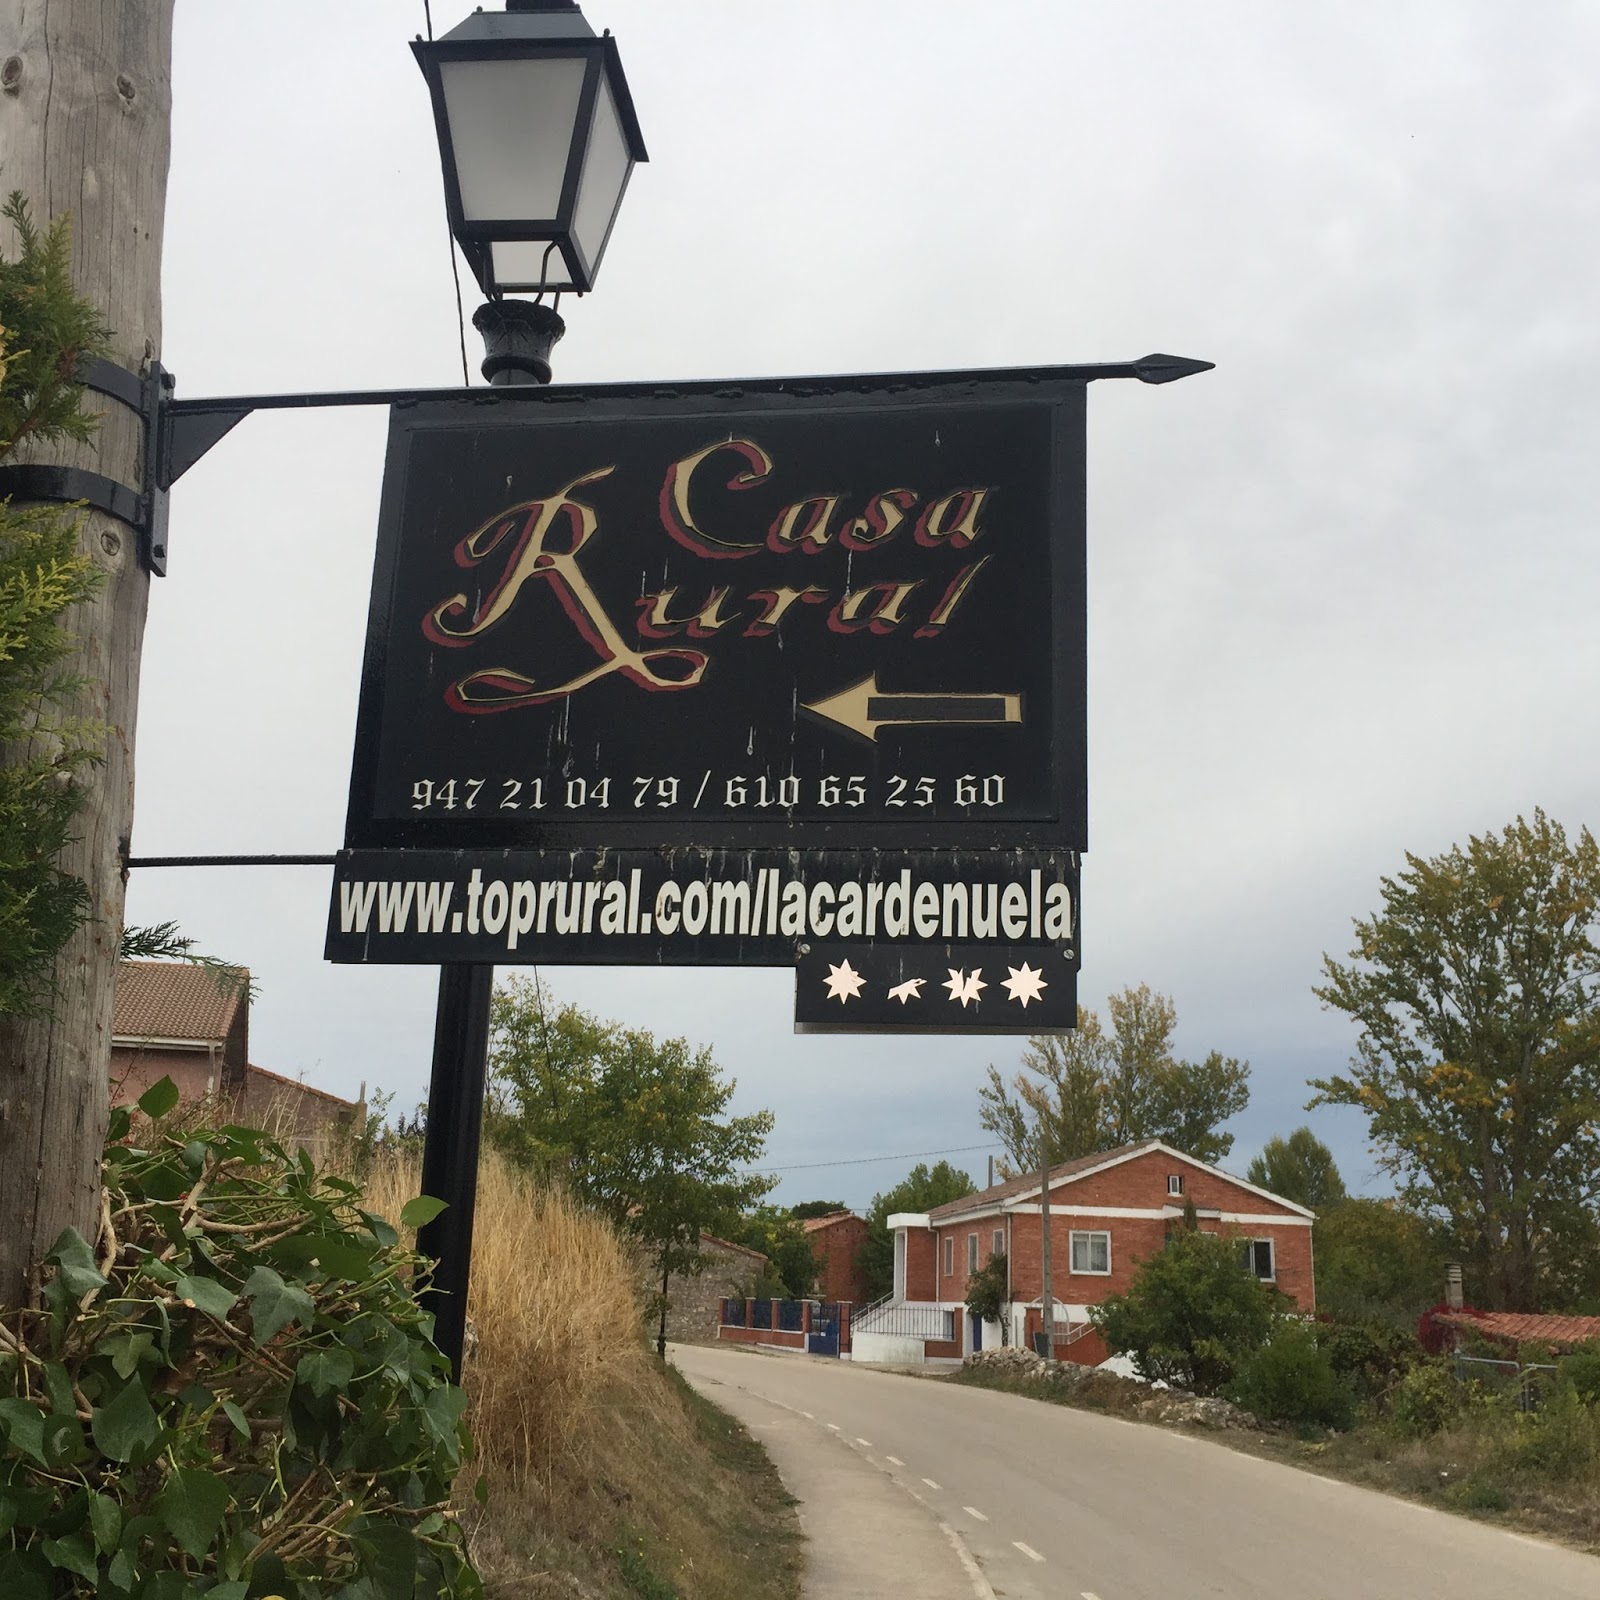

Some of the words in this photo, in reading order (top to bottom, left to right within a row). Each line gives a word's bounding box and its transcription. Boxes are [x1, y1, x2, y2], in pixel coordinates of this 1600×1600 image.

[660, 438, 992, 558] Casa
[422, 465, 994, 714] Rural
[411, 779, 484, 811] 947
[499, 778, 546, 811] 21
[563, 777, 610, 810] 04
[632, 776, 681, 809] 79
[724, 776, 800, 808] 610
[818, 776, 867, 807] 65
[885, 776, 936, 806] 25
[953, 775, 1007, 806] 60
[338, 868, 1073, 950] www.toprural.com/lacardenuela
